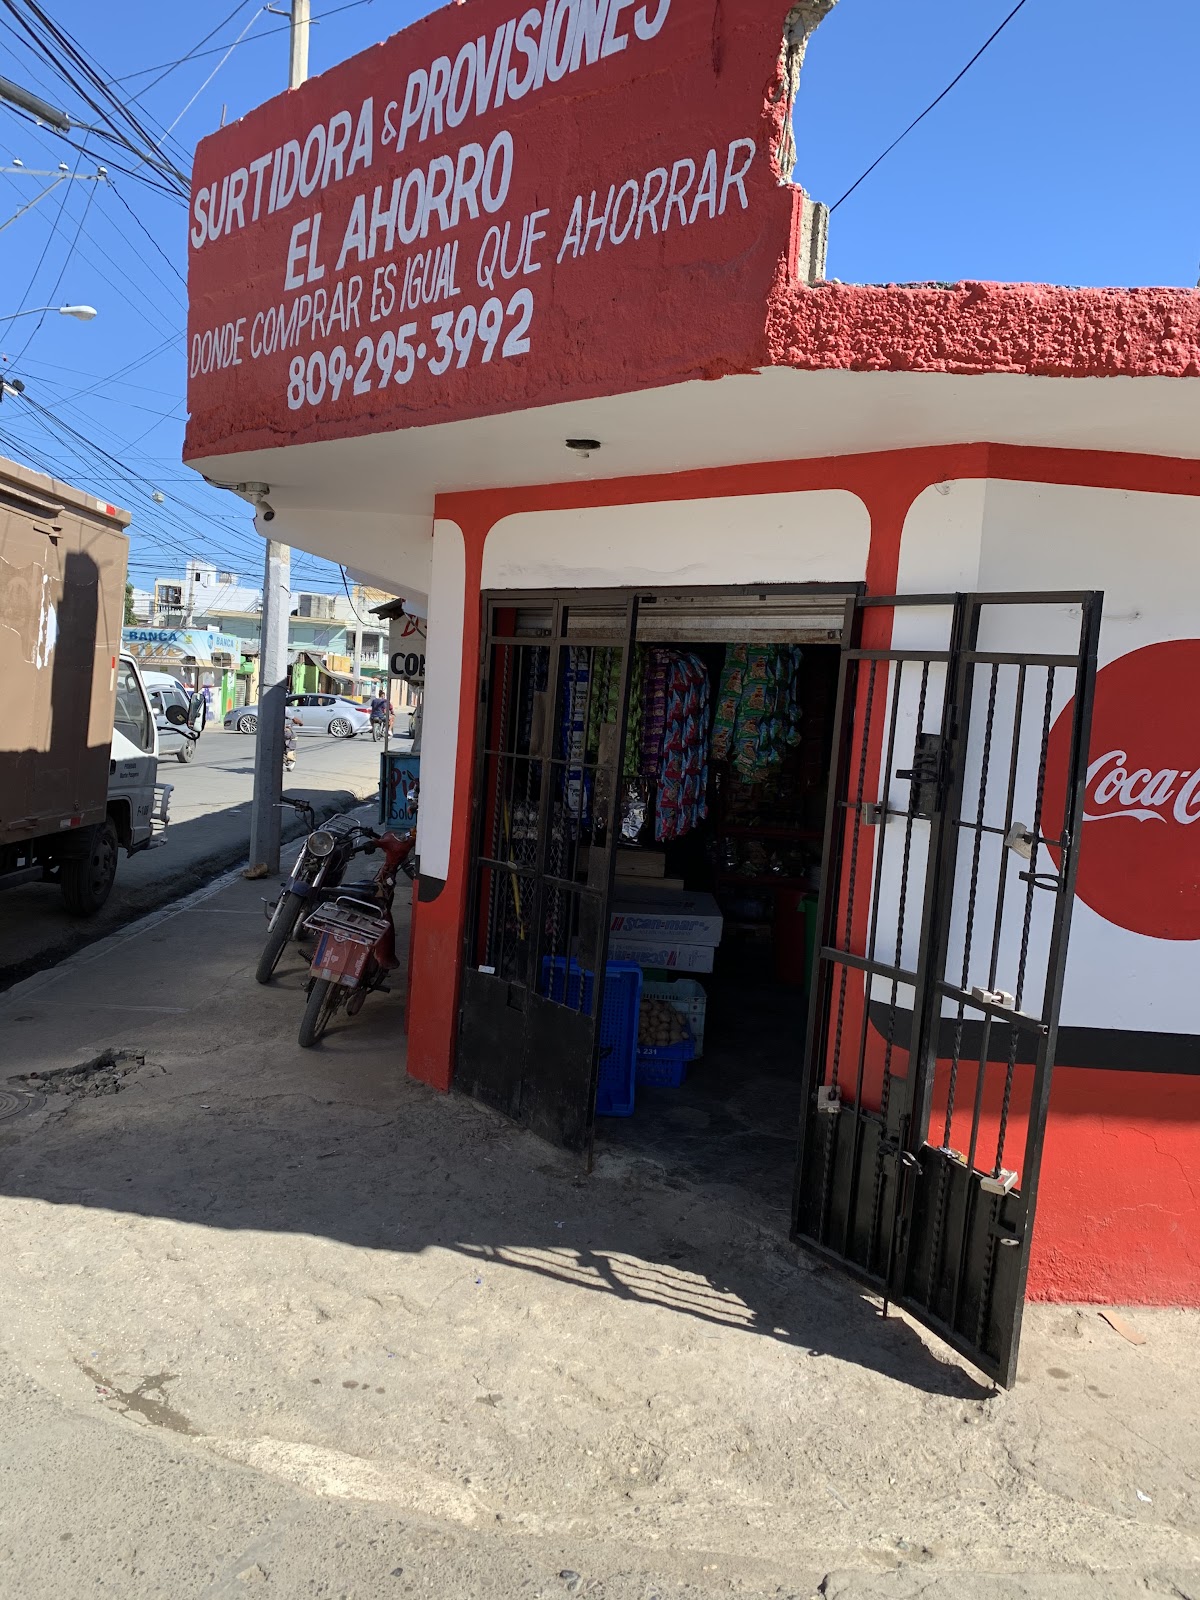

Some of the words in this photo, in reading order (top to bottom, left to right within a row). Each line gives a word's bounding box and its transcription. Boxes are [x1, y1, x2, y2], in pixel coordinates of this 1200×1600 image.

[191, 97, 373, 249] SURTIDORA
[284, 212, 325, 291] EL
[335, 130, 514, 271] AHORRO
[190, 318, 247, 378] DONDE
[251, 275, 363, 358] COMPRAR
[370, 263, 396, 322] ES
[400, 240, 460, 312] IGUAL
[477, 208, 550, 290] QUE
[557, 137, 756, 264] AHORRAR
[129, 631, 177, 642] BANCA
[216, 636, 233, 648] BANCA
